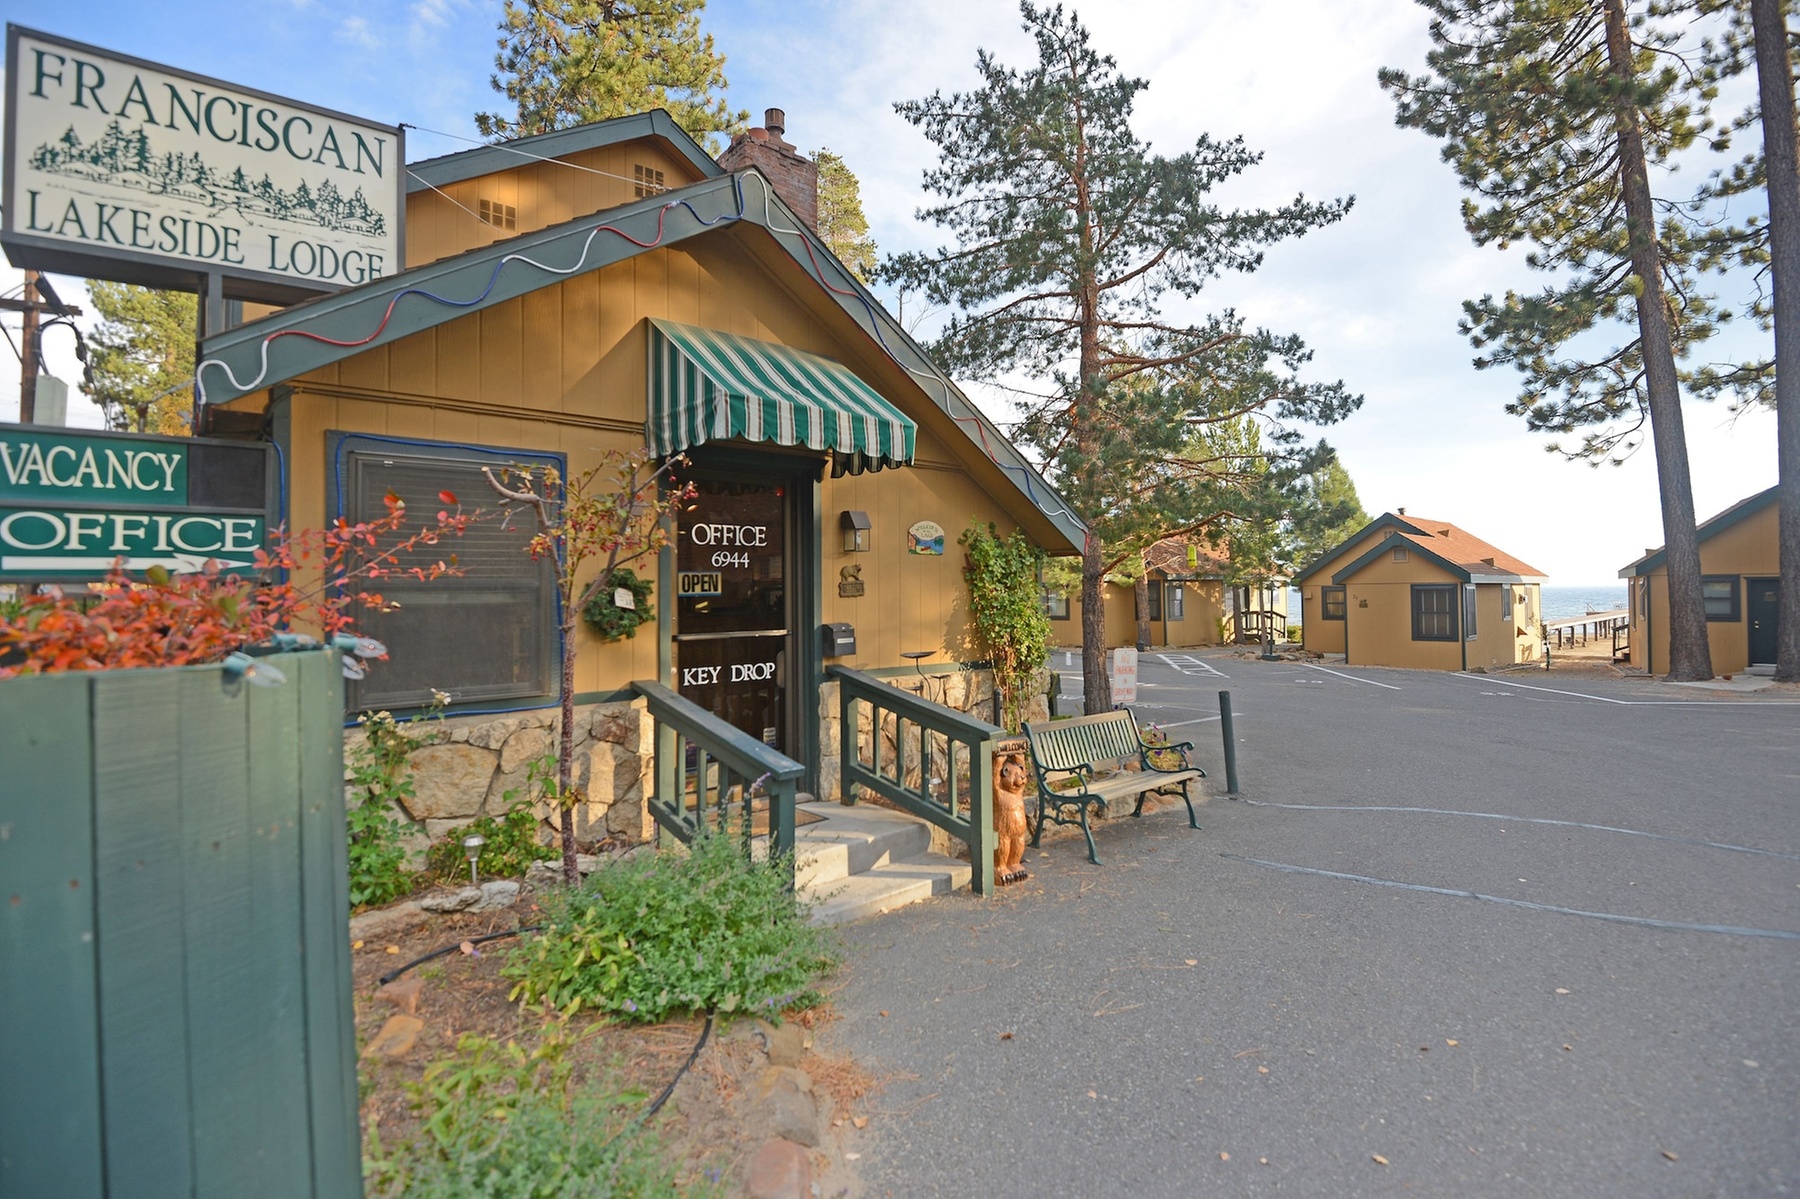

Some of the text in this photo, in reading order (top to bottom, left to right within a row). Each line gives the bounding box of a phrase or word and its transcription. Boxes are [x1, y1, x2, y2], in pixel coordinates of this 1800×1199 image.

[29, 47, 387, 179] FRANCISCAN
[26, 189, 384, 287] LAKESIDE LODGE
[0, 442, 182, 492] VACANCY
[0, 511, 261, 552] OFFICE
[691, 523, 768, 547] OFFICE
[711, 551, 750, 568] 6944
[682, 573, 719, 593] OPEN
[1116, 666, 1135, 675] PARKING
[1121, 654, 1131, 664] NO
[683, 662, 776, 686] KEY DROP
[1114, 688, 1134, 697] DRIVEWAY
